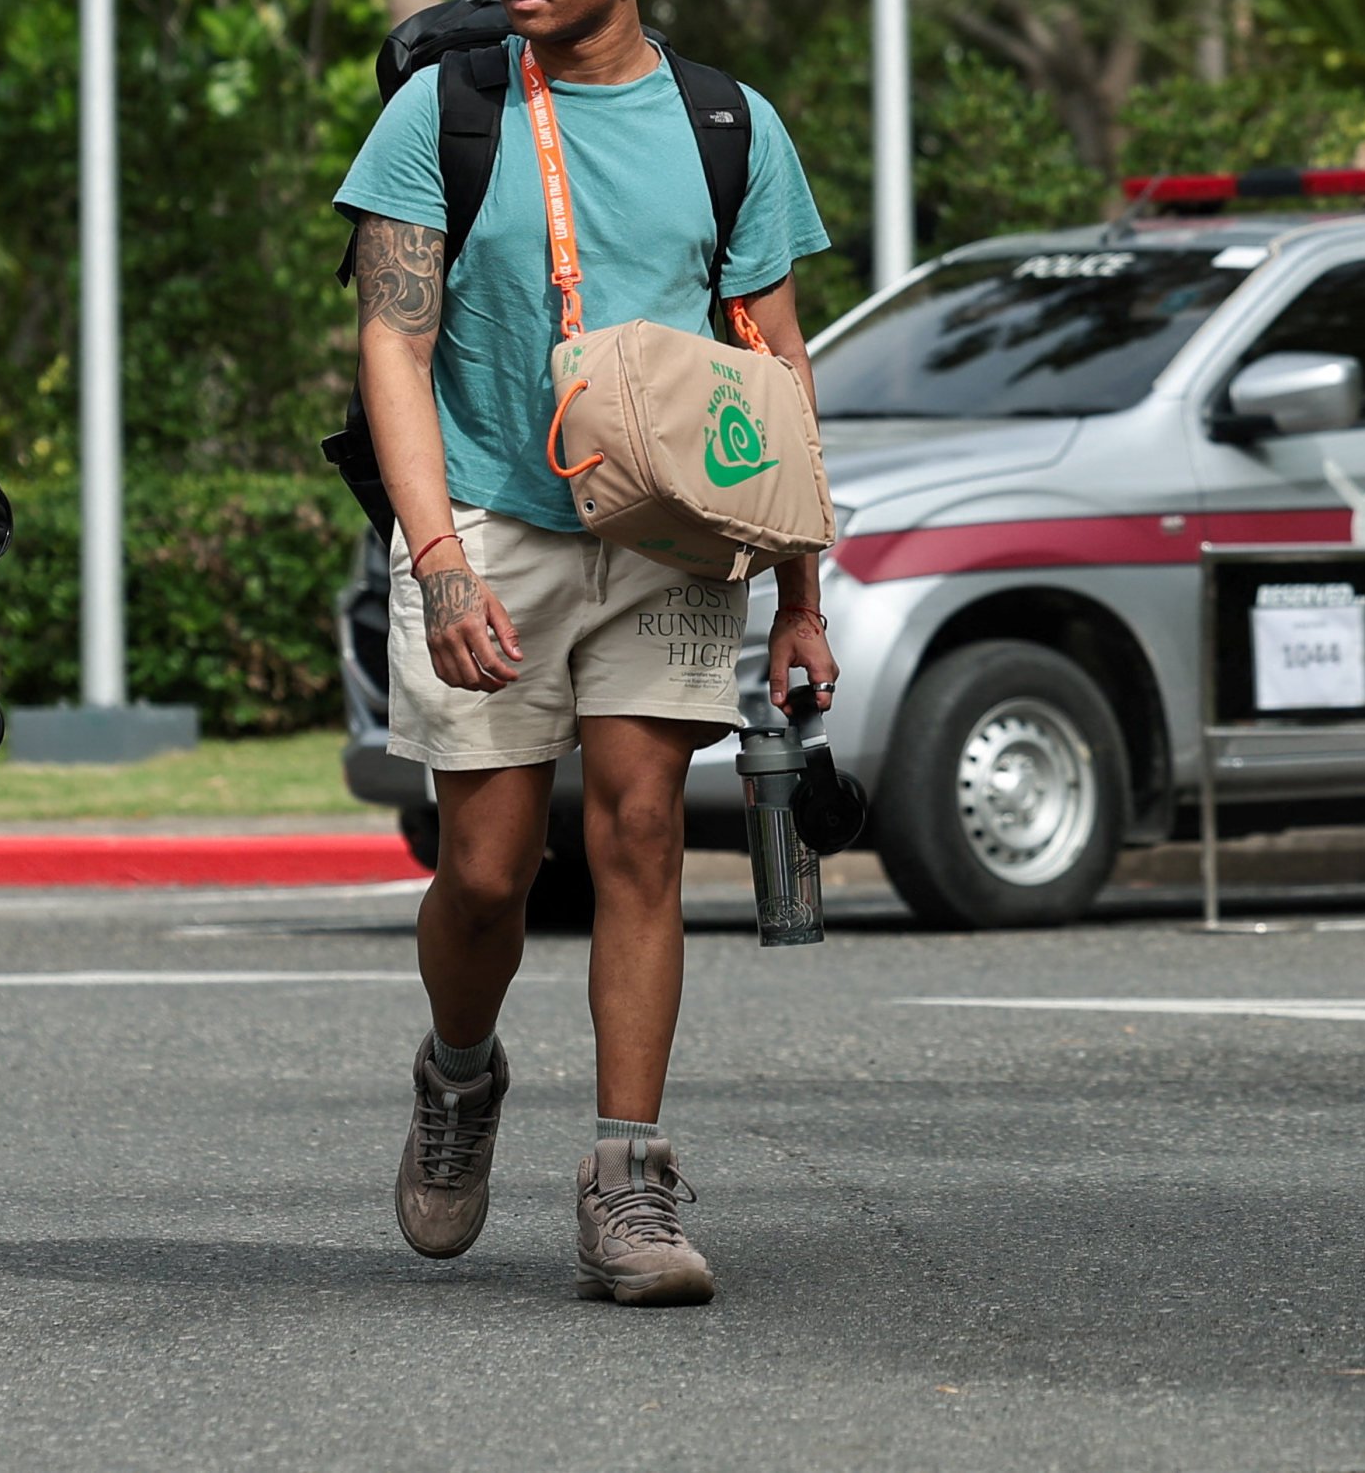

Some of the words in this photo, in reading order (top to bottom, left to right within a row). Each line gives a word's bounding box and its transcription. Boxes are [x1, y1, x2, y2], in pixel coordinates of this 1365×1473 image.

[547, 174, 563, 197] TRACE
[551, 197, 565, 217] YOUR
[553, 217, 568, 240] LEAVE
[710, 360, 743, 385] NIKE
[707, 384, 751, 419] MOVING
[664, 584, 731, 609] POST
[666, 642, 732, 668] HIGH
